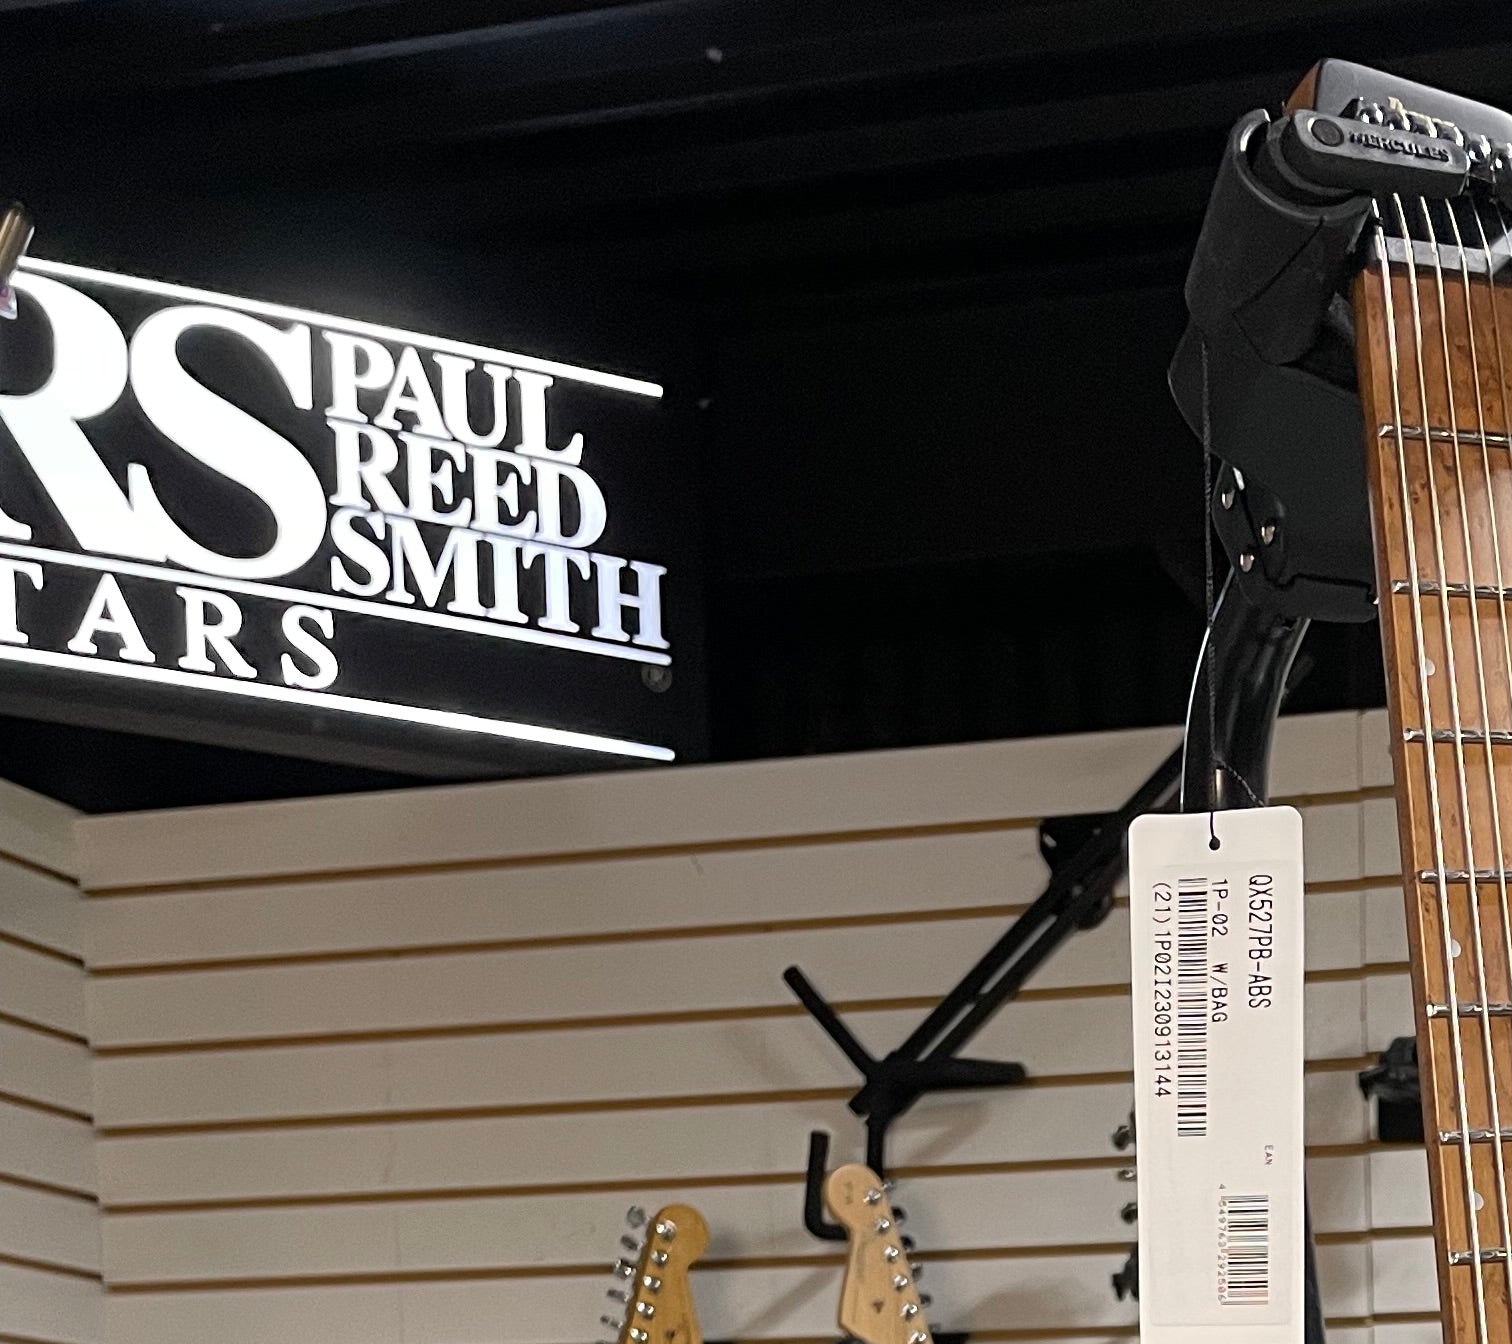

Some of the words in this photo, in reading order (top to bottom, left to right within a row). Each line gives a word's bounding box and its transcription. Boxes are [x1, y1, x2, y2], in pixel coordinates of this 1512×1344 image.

[1350, 131, 1450, 162] HERCULES
[325, 330, 583, 466] PAUL
[326, 417, 608, 550] REED
[330, 506, 670, 650] SMITH
[1211, 879, 1229, 937] 1P-02
[1248, 874, 1273, 1008] QX527PB-ABS
[1210, 963, 1229, 1023] W/BAG
[1264, 1144, 1274, 1165] EAN
